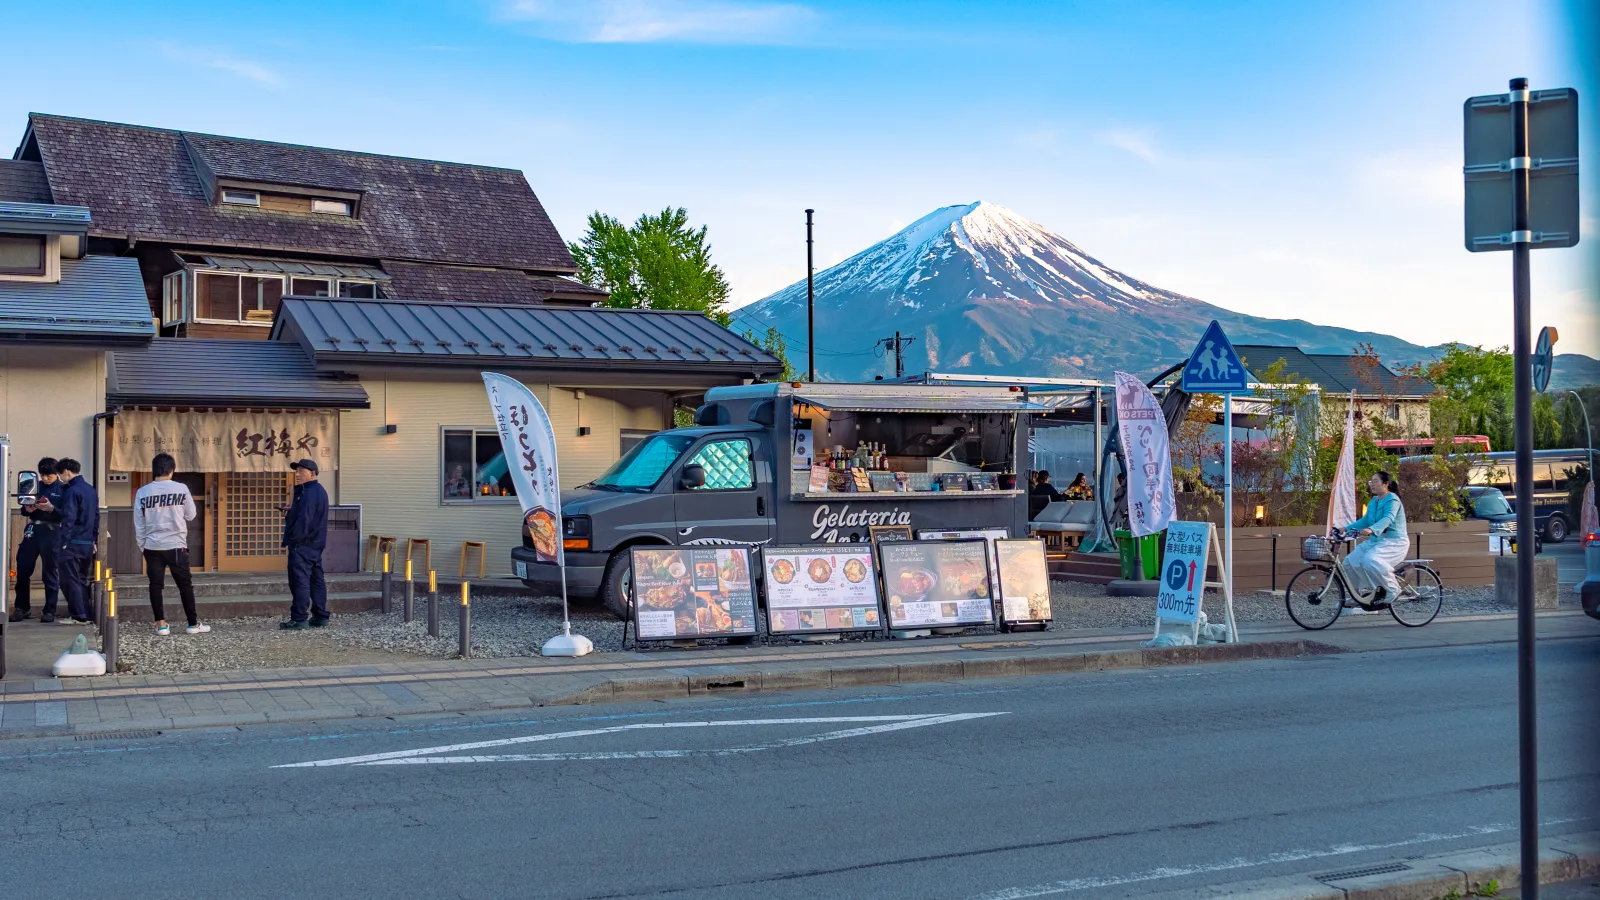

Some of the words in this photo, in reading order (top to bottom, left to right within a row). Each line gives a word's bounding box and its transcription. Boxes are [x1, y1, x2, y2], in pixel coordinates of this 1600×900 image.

[236, 427, 319, 458] 紅梅や
[140, 493, 187, 509] SUPREME
[811, 504, 911, 539] Gelateria
[1168, 531, 1203, 543] 大型バス
[1166, 543, 1203, 556] 無料駐車場
[1158, 592, 1195, 615] 300m先
